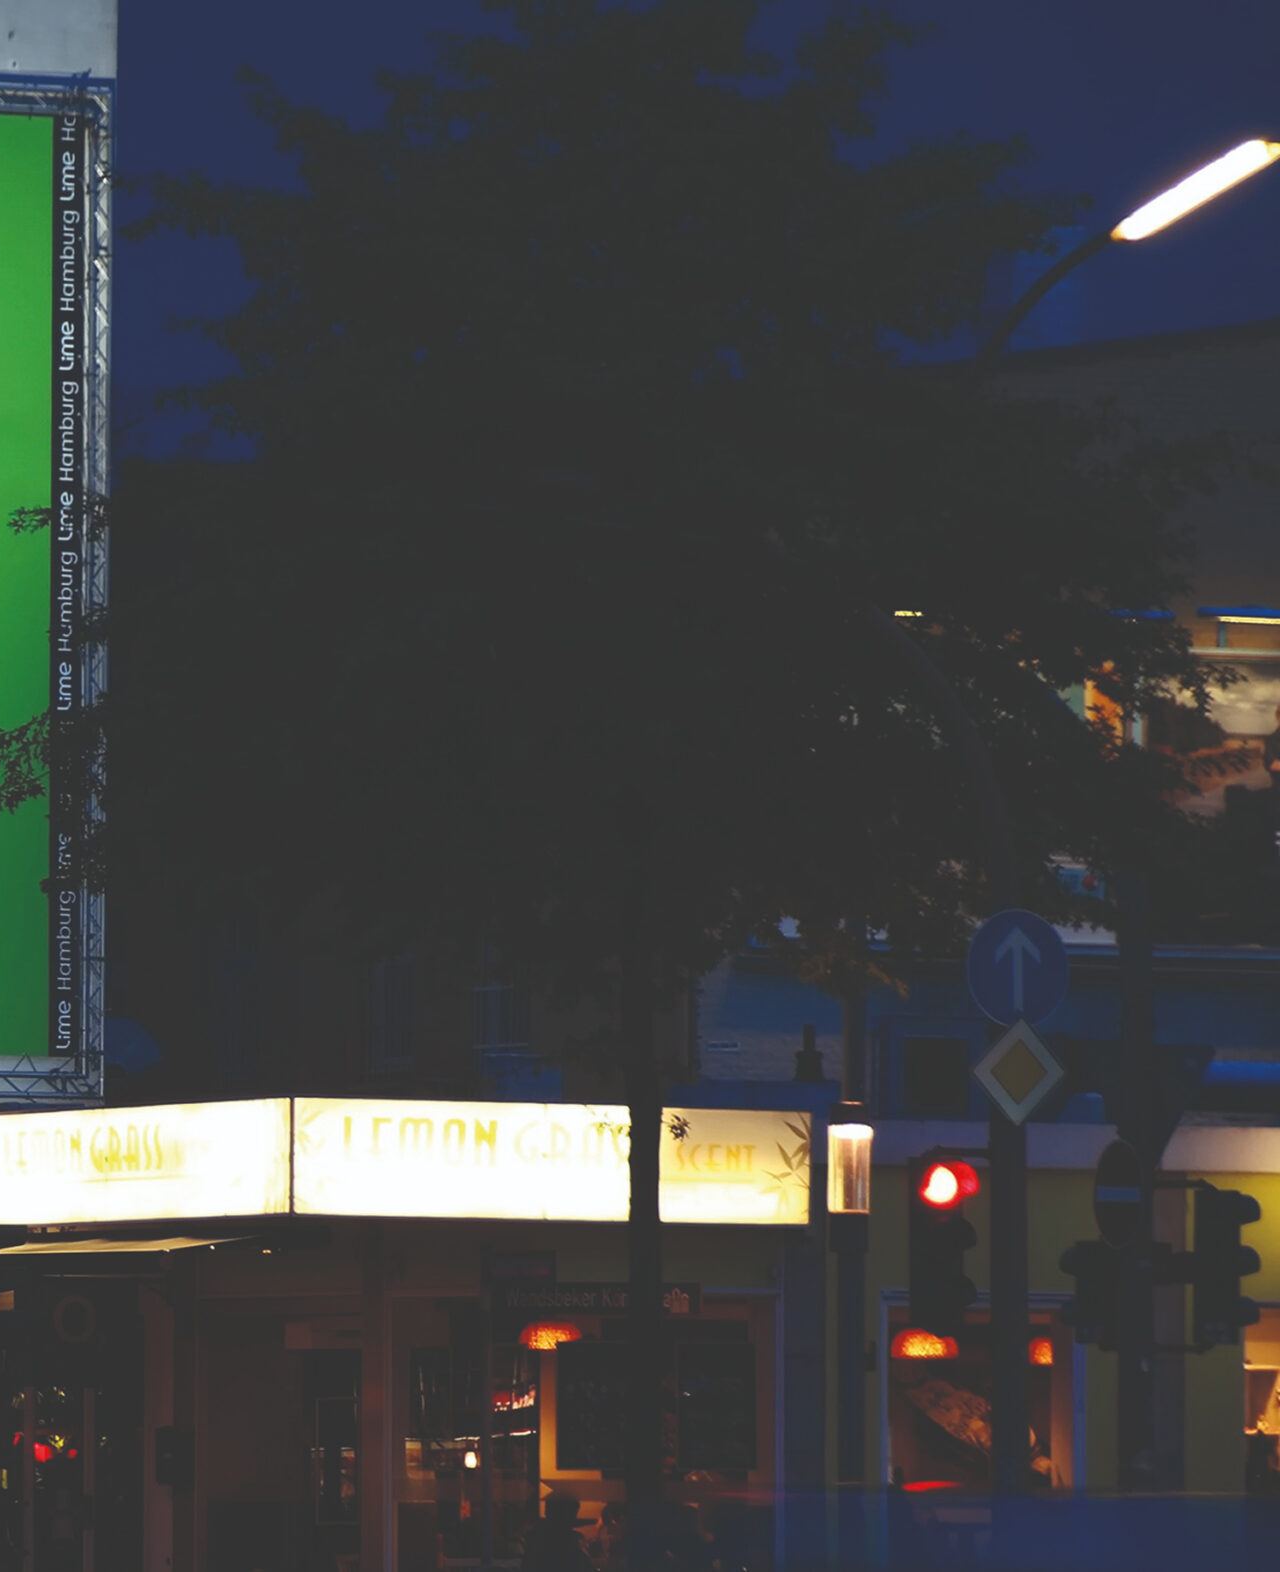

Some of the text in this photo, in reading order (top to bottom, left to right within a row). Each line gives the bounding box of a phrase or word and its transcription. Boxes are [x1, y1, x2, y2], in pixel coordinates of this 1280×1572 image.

[60, 151, 74, 201] Lime
[60, 210, 79, 311] Hamburg
[59, 320, 74, 371] Lime
[59, 381, 79, 481] Hamburg
[58, 491, 73, 541] Lime
[58, 551, 78, 651] Hamburg
[57, 662, 72, 711] Lime
[57, 890, 76, 990] Hamburg
[56, 1000, 72, 1049] Lime
[89, 1122, 162, 1174] GRASS
[343, 1116, 499, 1167] LEMON
[677, 1143, 757, 1173] SCENT
[506, 1287, 597, 1309] Wandsbeker
